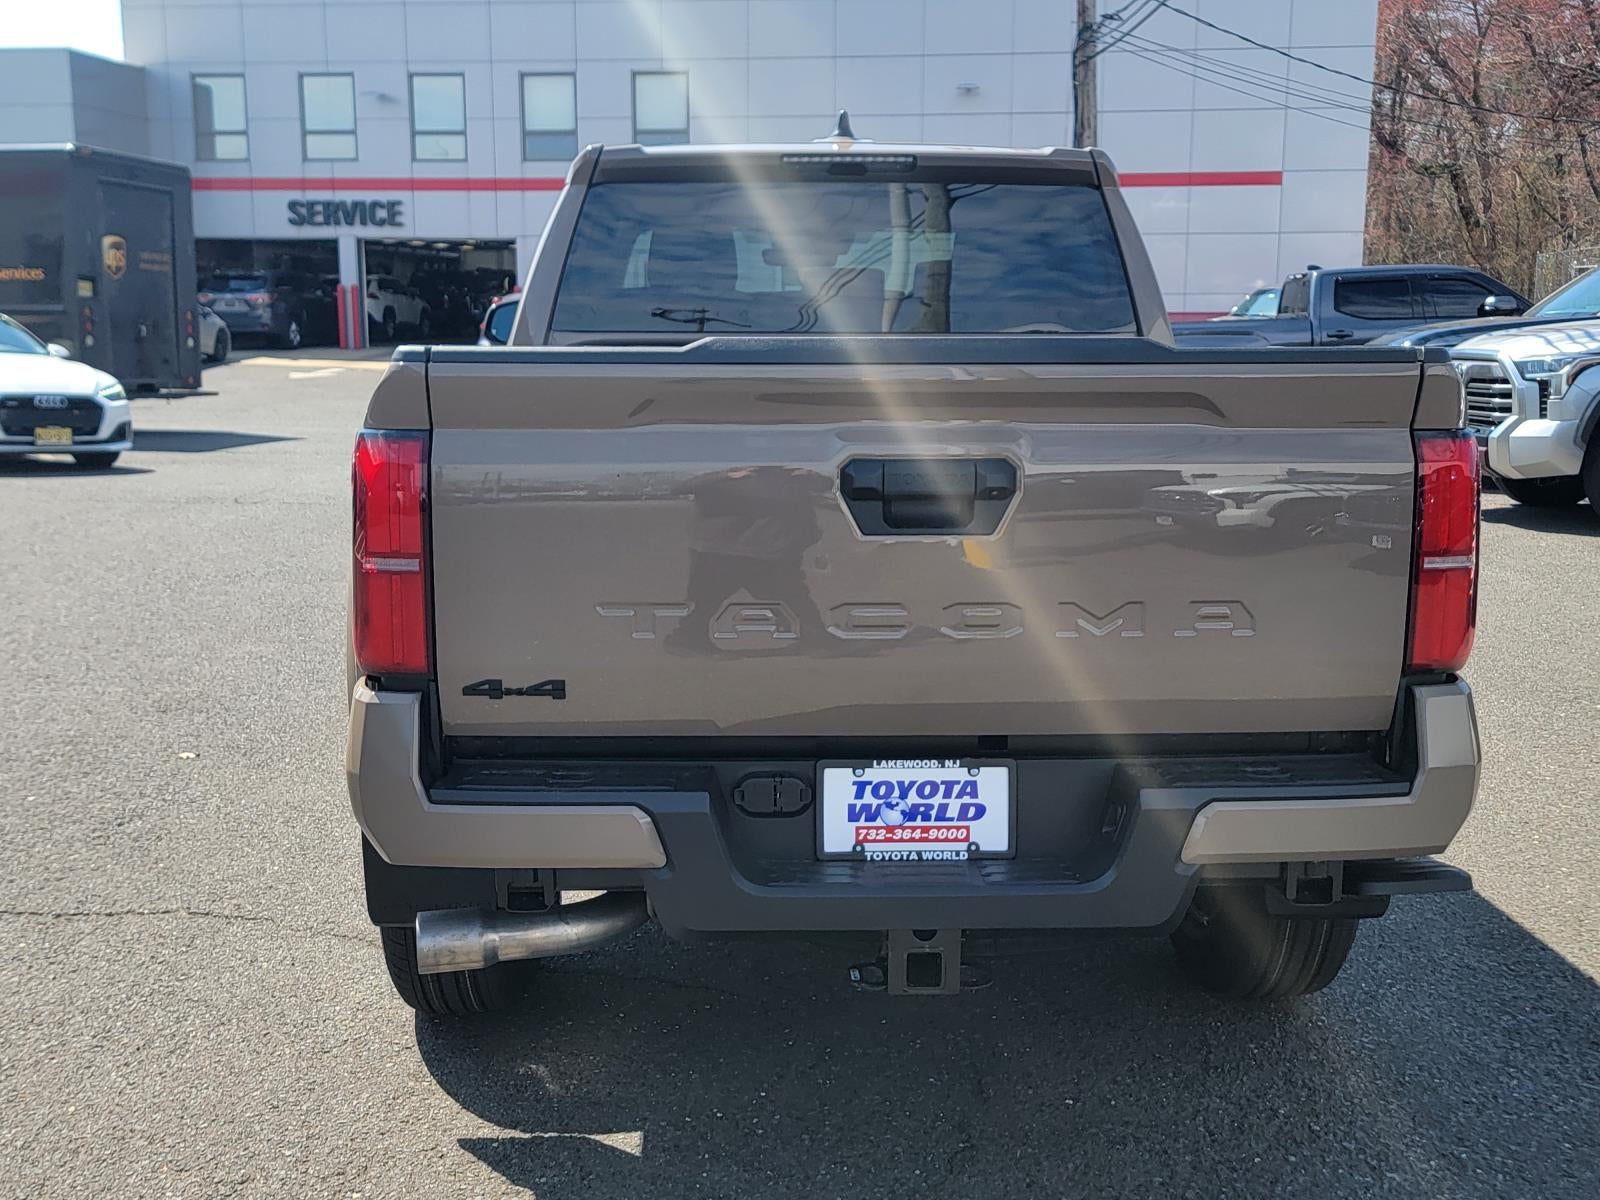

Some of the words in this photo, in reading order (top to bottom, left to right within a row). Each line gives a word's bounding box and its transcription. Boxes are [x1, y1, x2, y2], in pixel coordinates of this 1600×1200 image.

[287, 199, 404, 226] SERVICE
[887, 472, 970, 486] TOYTA
[595, 601, 1256, 640] TACOMA
[463, 679, 566, 700] 4x4
[873, 759, 942, 769] LAKEWOOD,
[944, 759, 960, 768] NJ
[851, 780, 979, 800] TOYOTA
[848, 797, 987, 826] WORLD
[858, 828, 967, 840] 732-364-9000
[865, 851, 918, 861] TOYOTA
[922, 850, 968, 861] WORLD
